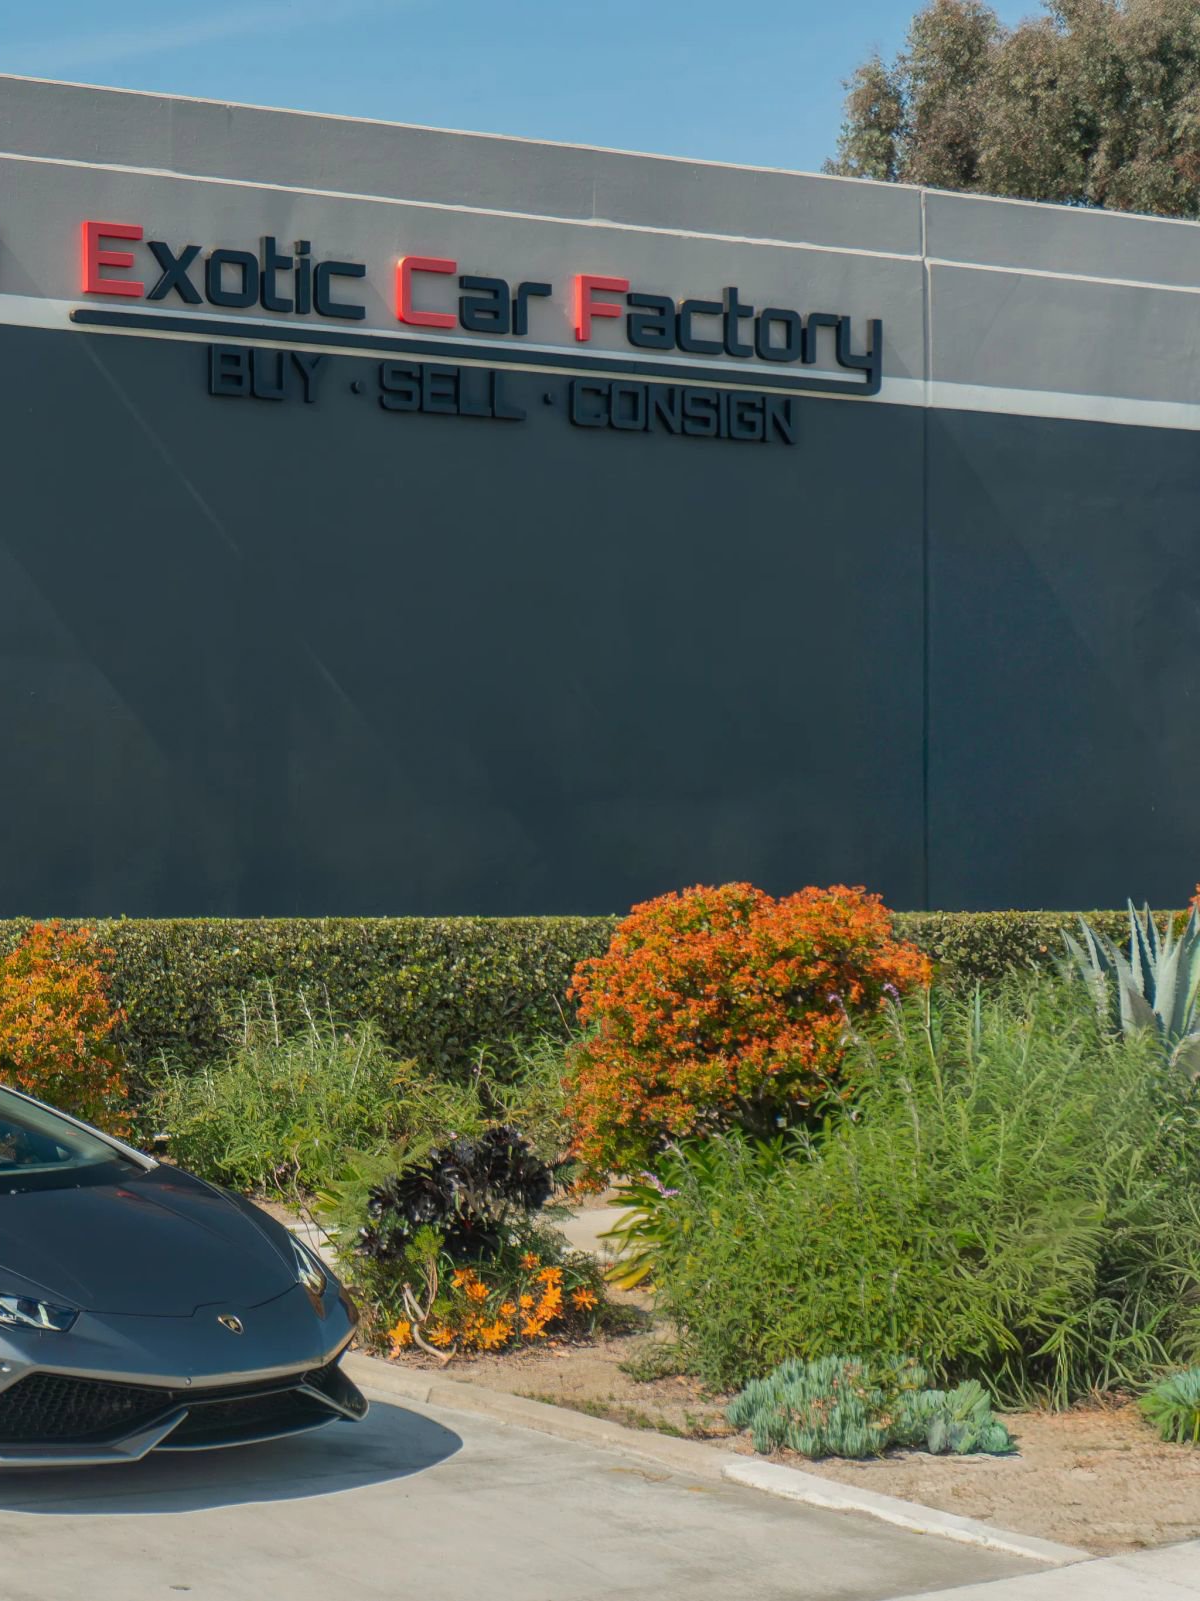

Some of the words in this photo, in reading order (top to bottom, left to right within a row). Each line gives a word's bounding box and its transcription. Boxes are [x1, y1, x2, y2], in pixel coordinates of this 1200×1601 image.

[81, 220, 366, 320] Exotic
[396, 255, 552, 335] Car
[574, 274, 883, 396] Factory
[208, 344, 323, 404] BUY
[378, 360, 527, 421] SELL
[569, 378, 797, 445] CONSIGN
